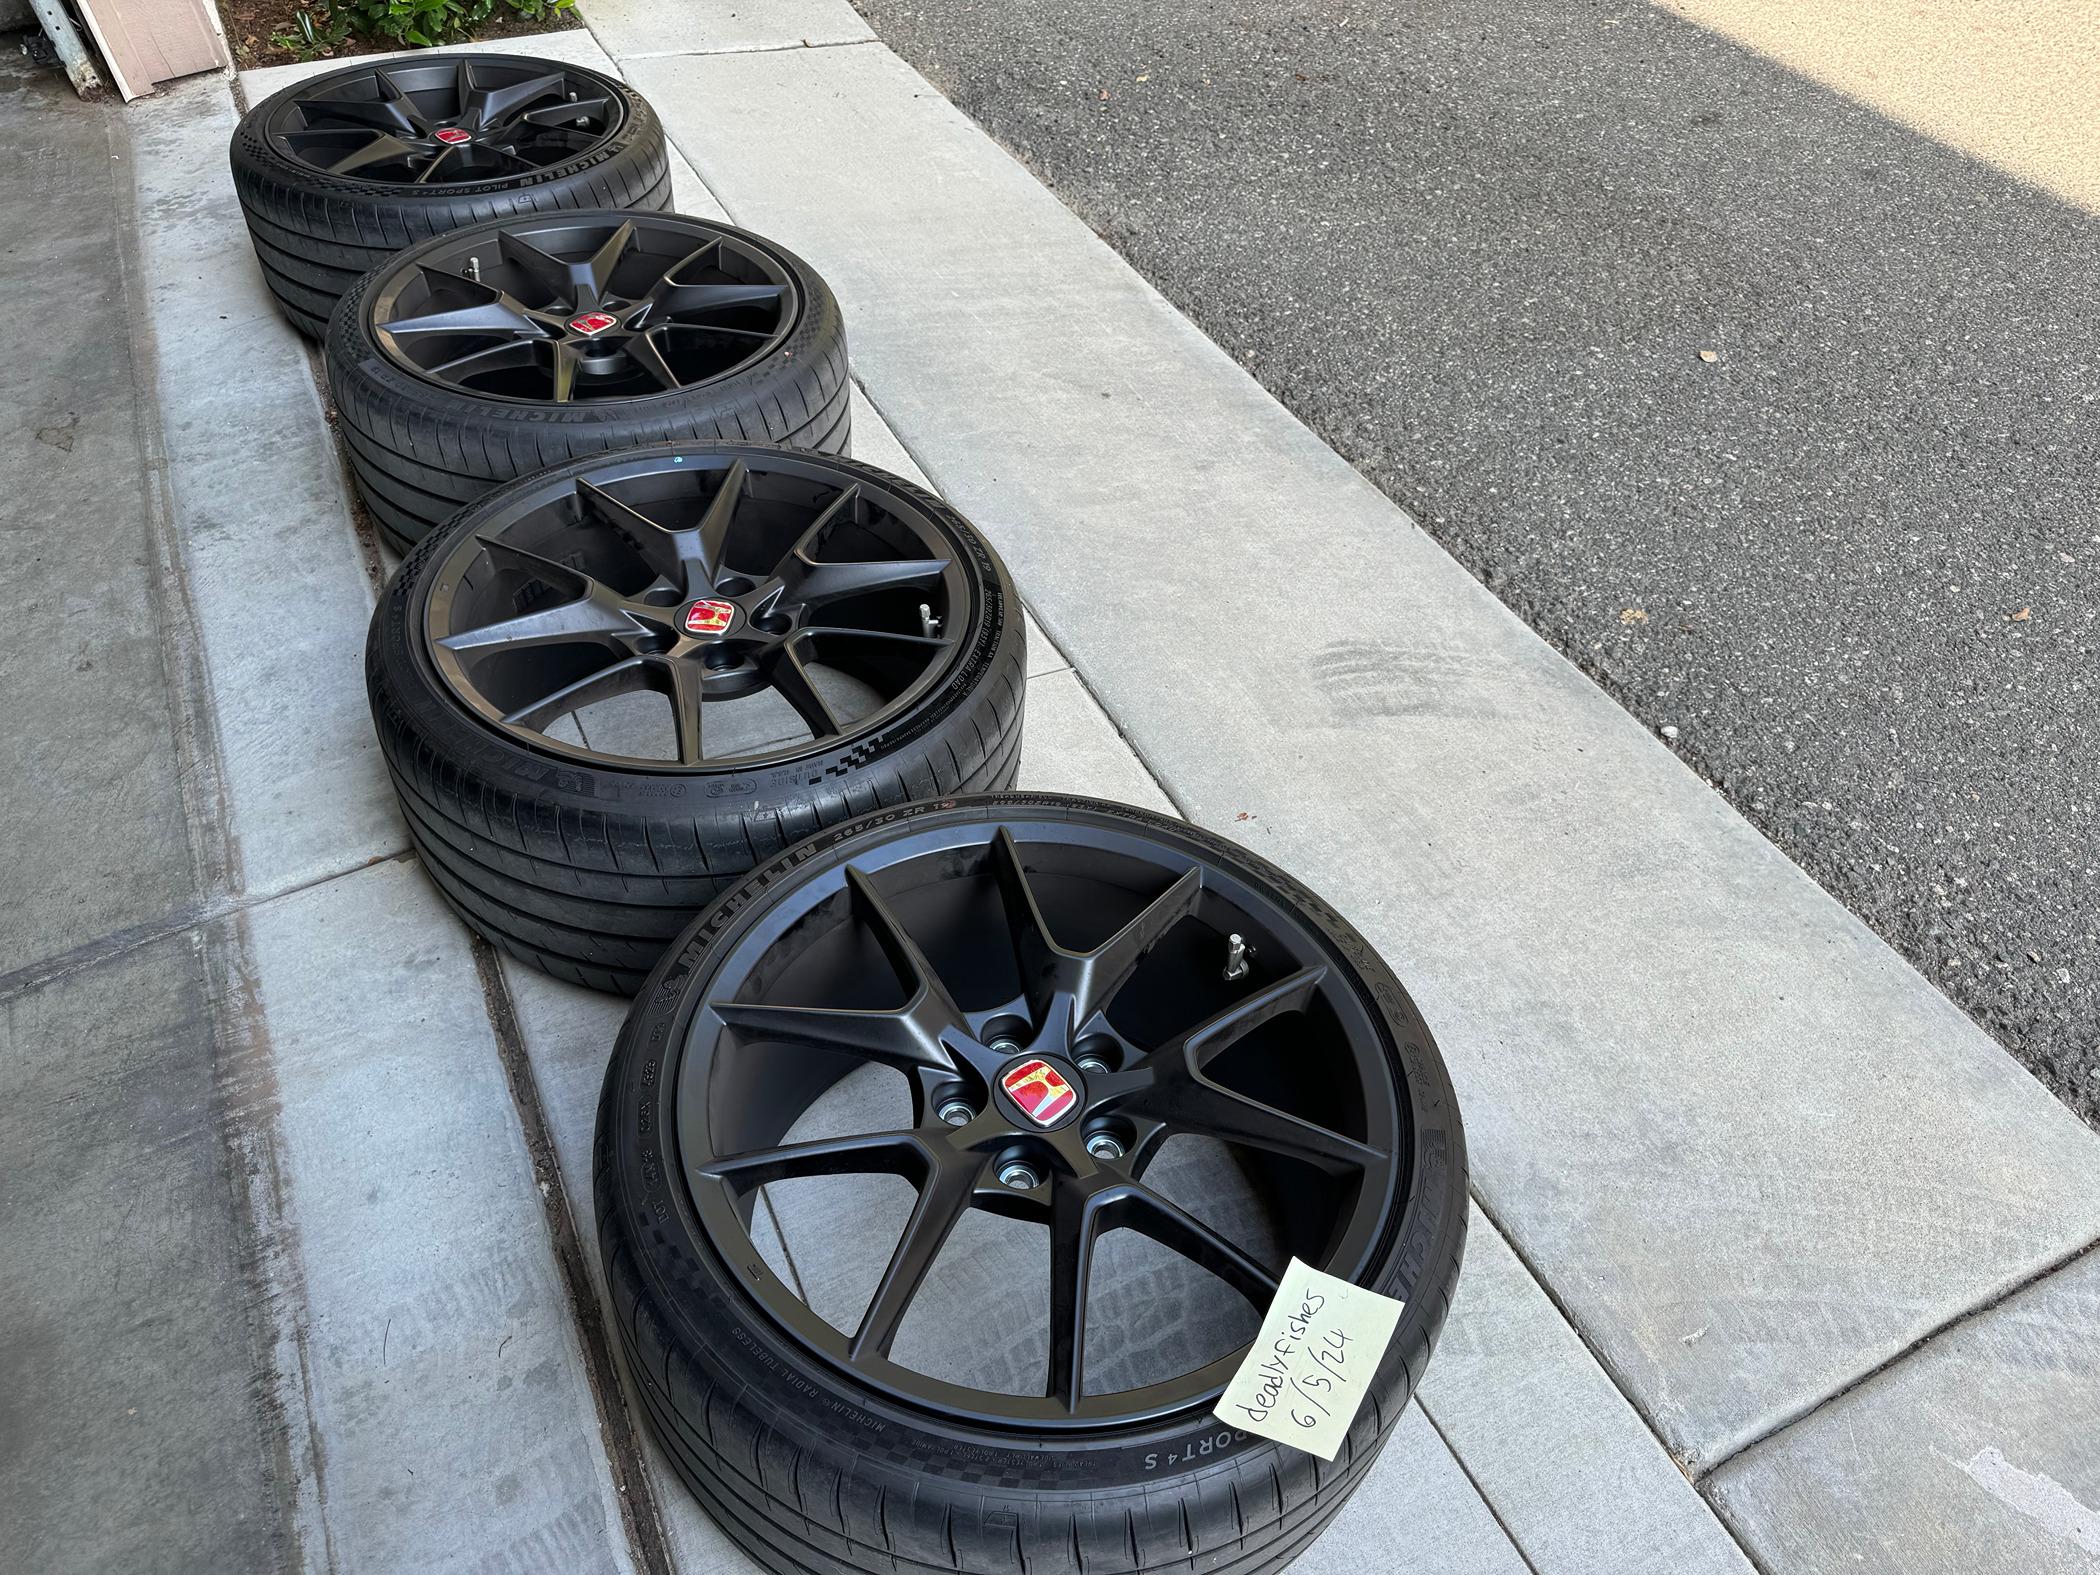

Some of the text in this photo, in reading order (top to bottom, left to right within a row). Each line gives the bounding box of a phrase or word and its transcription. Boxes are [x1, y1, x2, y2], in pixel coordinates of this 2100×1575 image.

[475, 182, 509, 192] PILOT
[520, 151, 611, 188] MICHELIN
[429, 188, 470, 196] SPORT
[951, 670, 969, 690] LOAD
[966, 648, 981, 673] EXTRA
[678, 800, 956, 968] MICHELIN 265/30 ZR 19
[1387, 1176, 1438, 1300] MICHE
[731, 1326, 779, 1371] TUBELESS
[1236, 1288, 1325, 1422] deadlyfishes
[780, 1367, 820, 1398] RADIAL
[1290, 1328, 1354, 1428] 6/5/24
[1144, 1430, 1249, 1471] PORT 4 S
